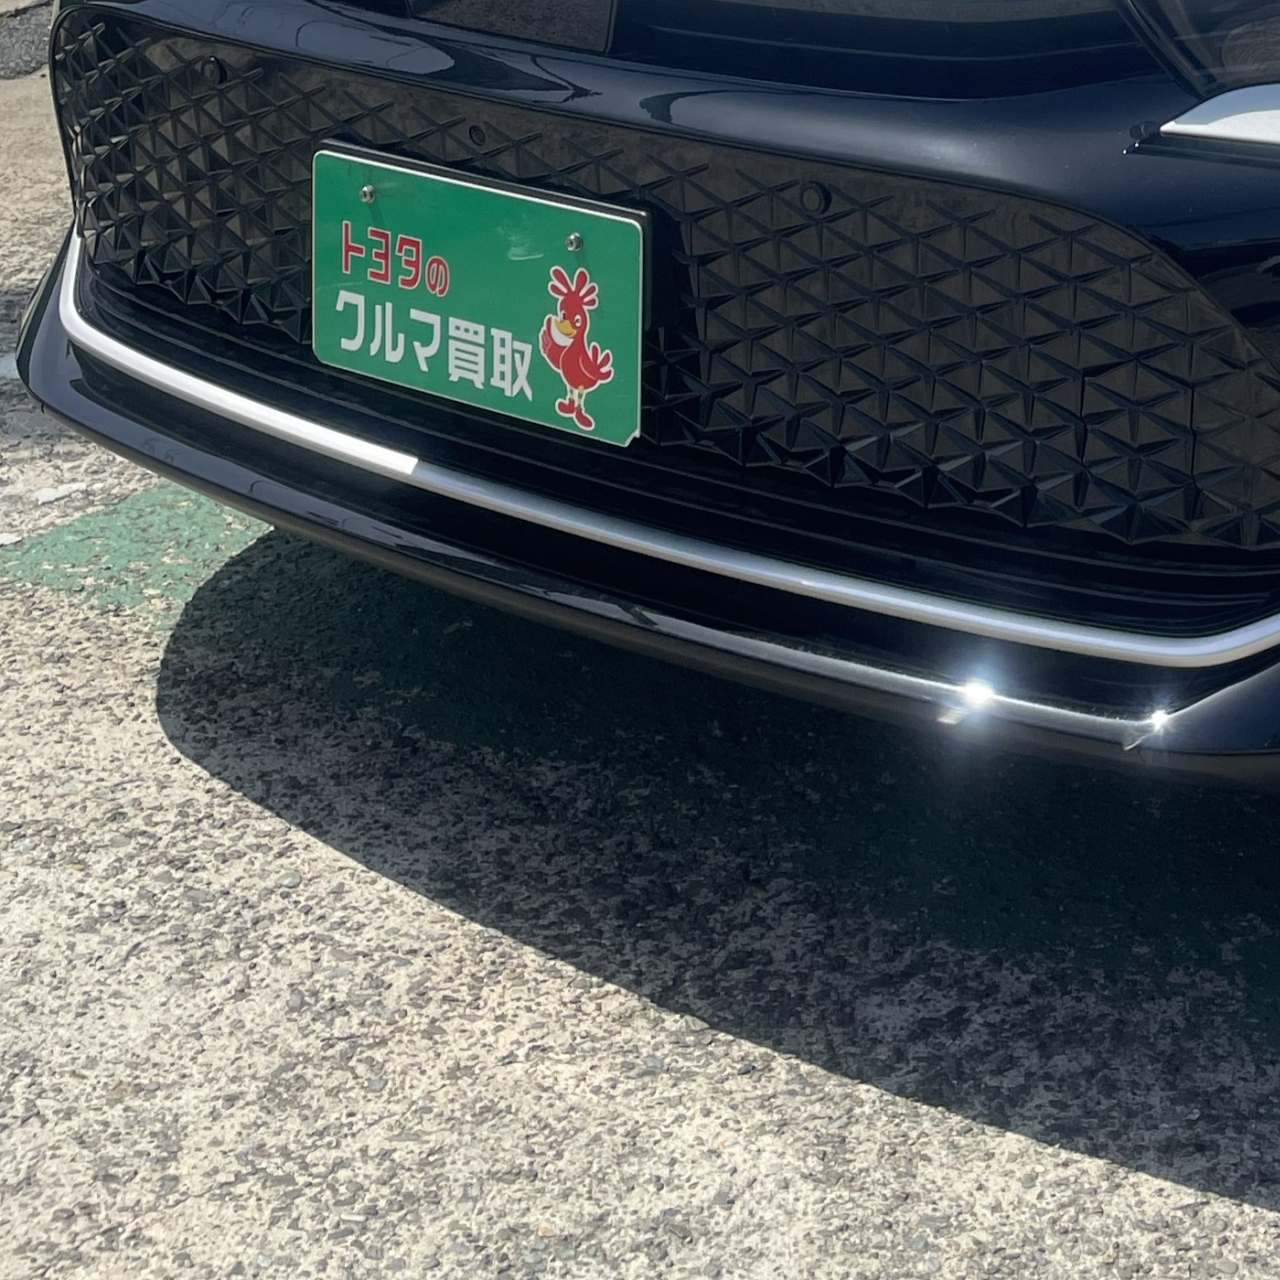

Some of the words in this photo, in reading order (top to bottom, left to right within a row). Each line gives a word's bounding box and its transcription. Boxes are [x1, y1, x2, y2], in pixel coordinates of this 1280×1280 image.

[341, 220, 450, 297] トヨタの
[335, 289, 533, 402] クルマ買取
